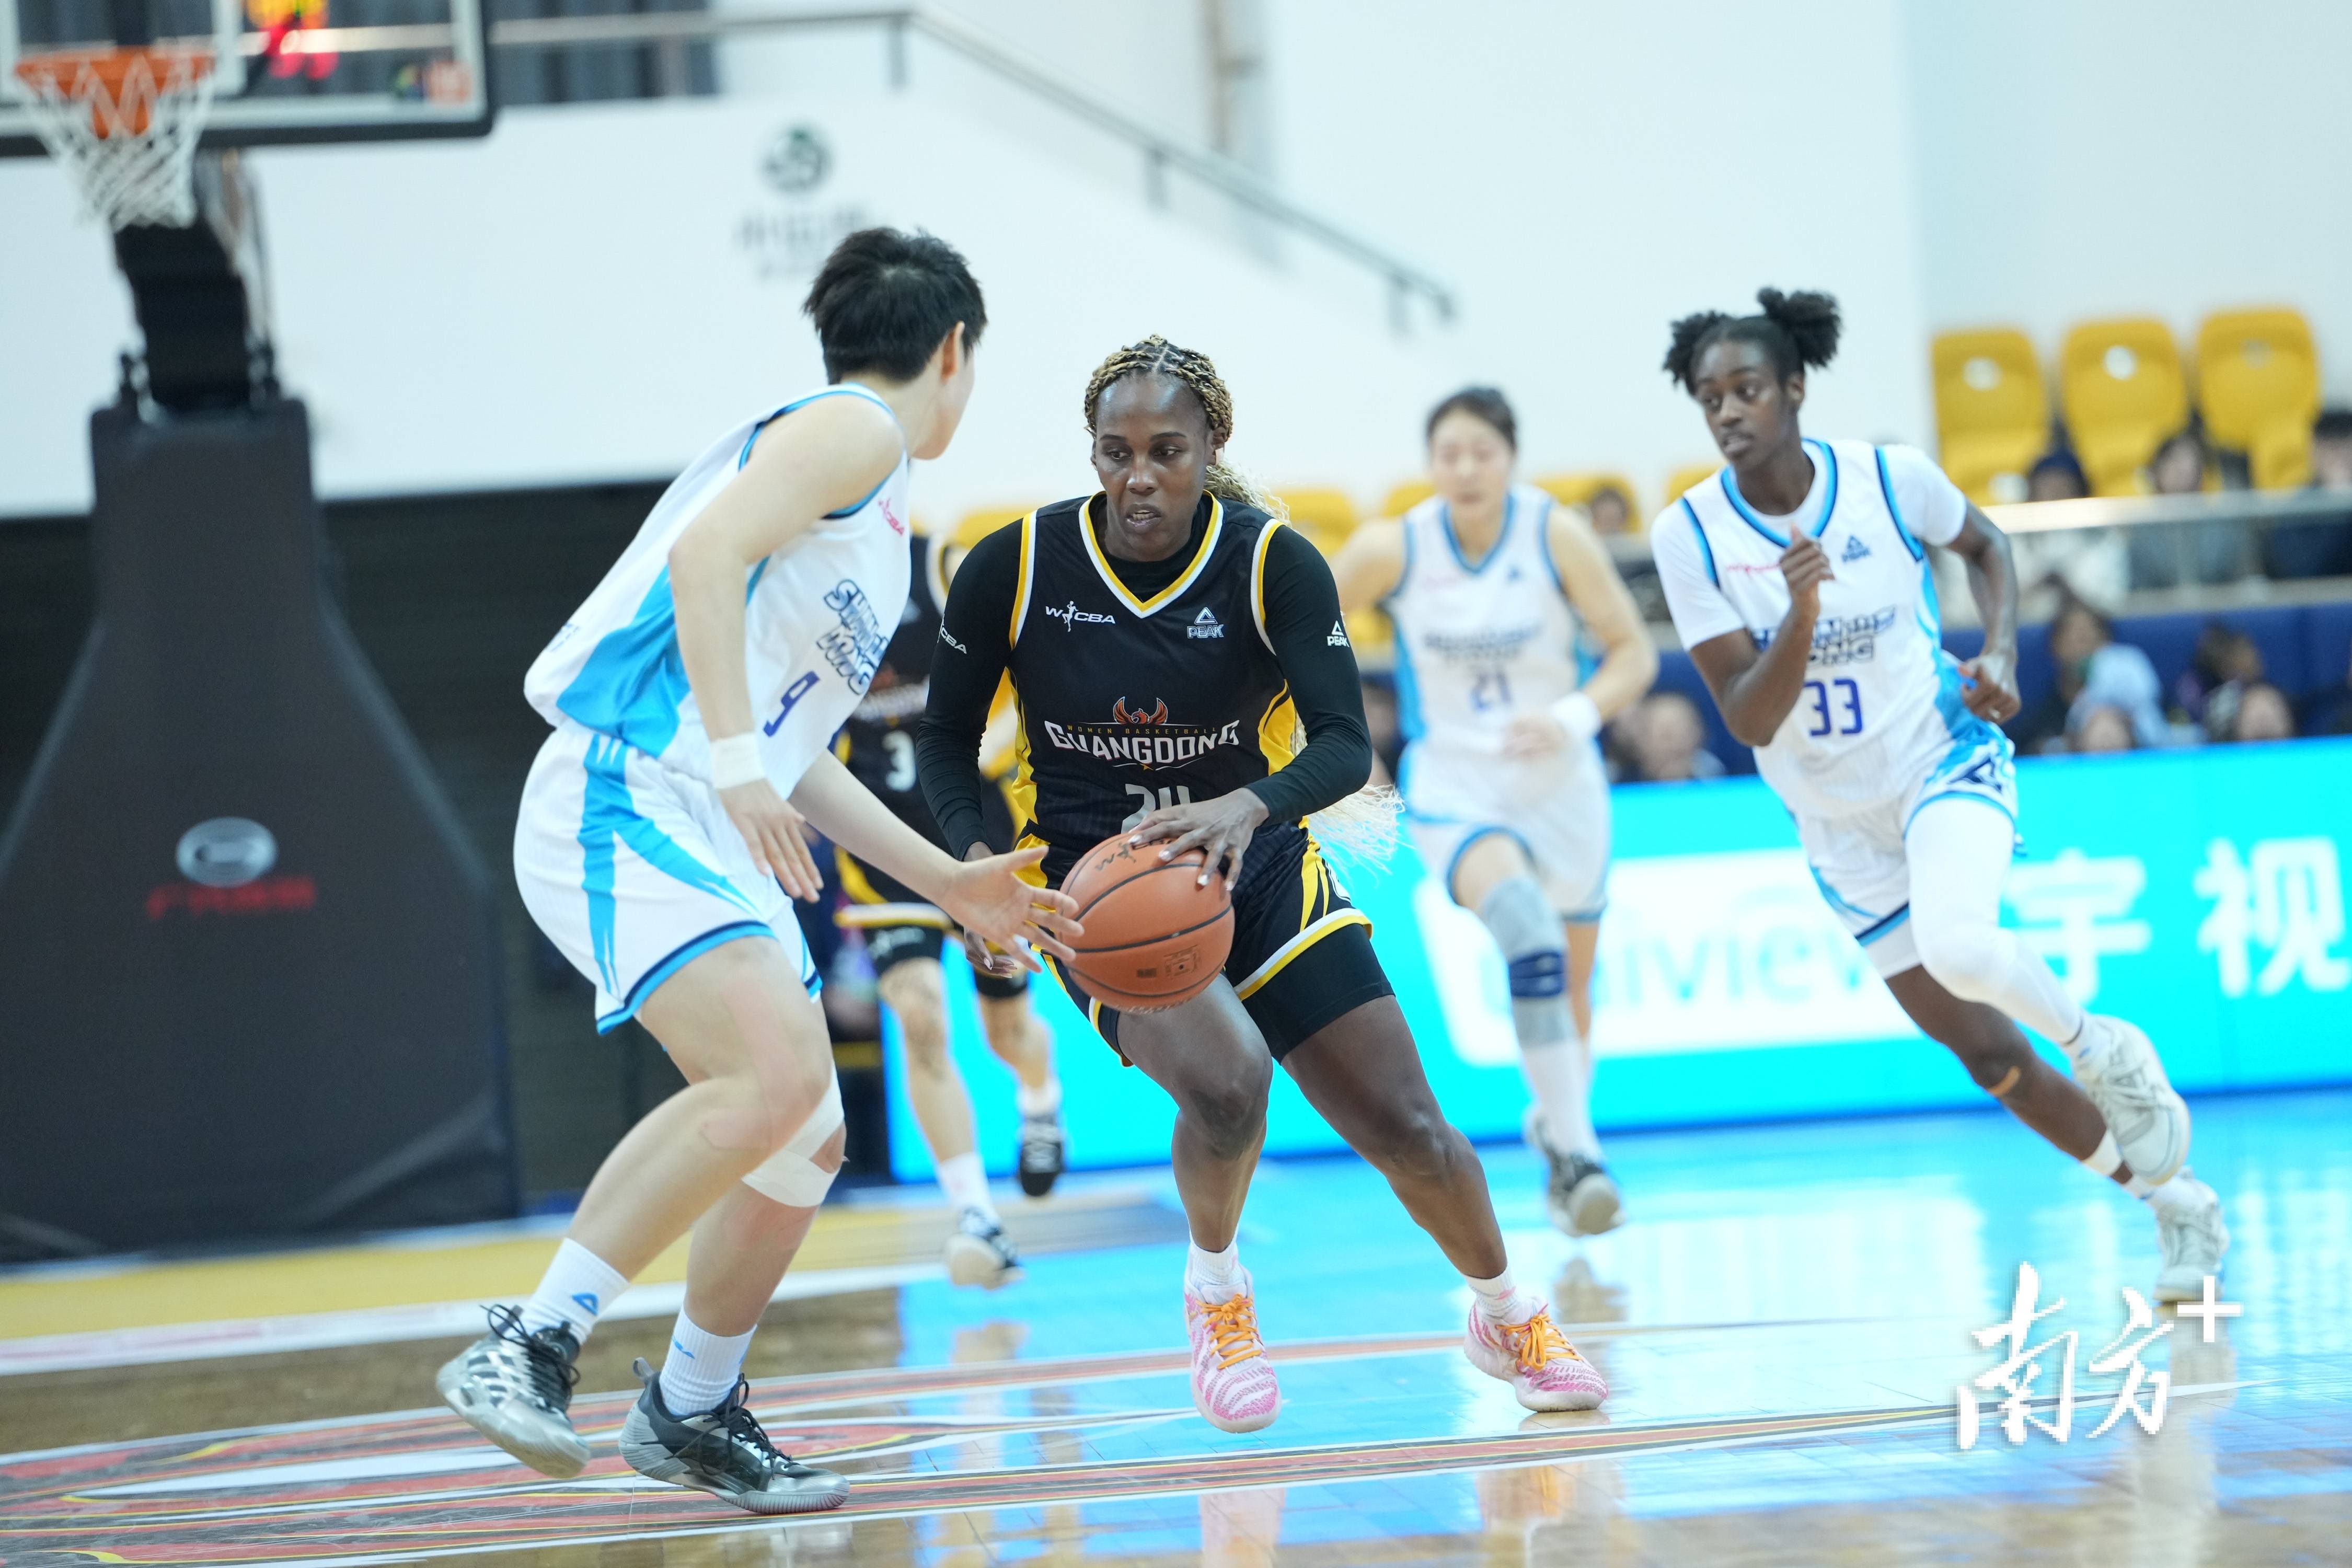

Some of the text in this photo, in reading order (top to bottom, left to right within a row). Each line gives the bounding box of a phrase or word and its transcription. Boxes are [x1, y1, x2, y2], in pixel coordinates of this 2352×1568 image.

[1186, 624, 1225, 639] PEAK
[1327, 636, 1350, 648] PEAK
[763, 671, 821, 737] 9
[1067, 724, 1112, 734] WOMEN
[1803, 679, 1863, 737] 33
[882, 730, 917, 793] 3
[1044, 719, 1240, 764] GUANGDONG
[1999, 837, 2351, 1002] 宇视
